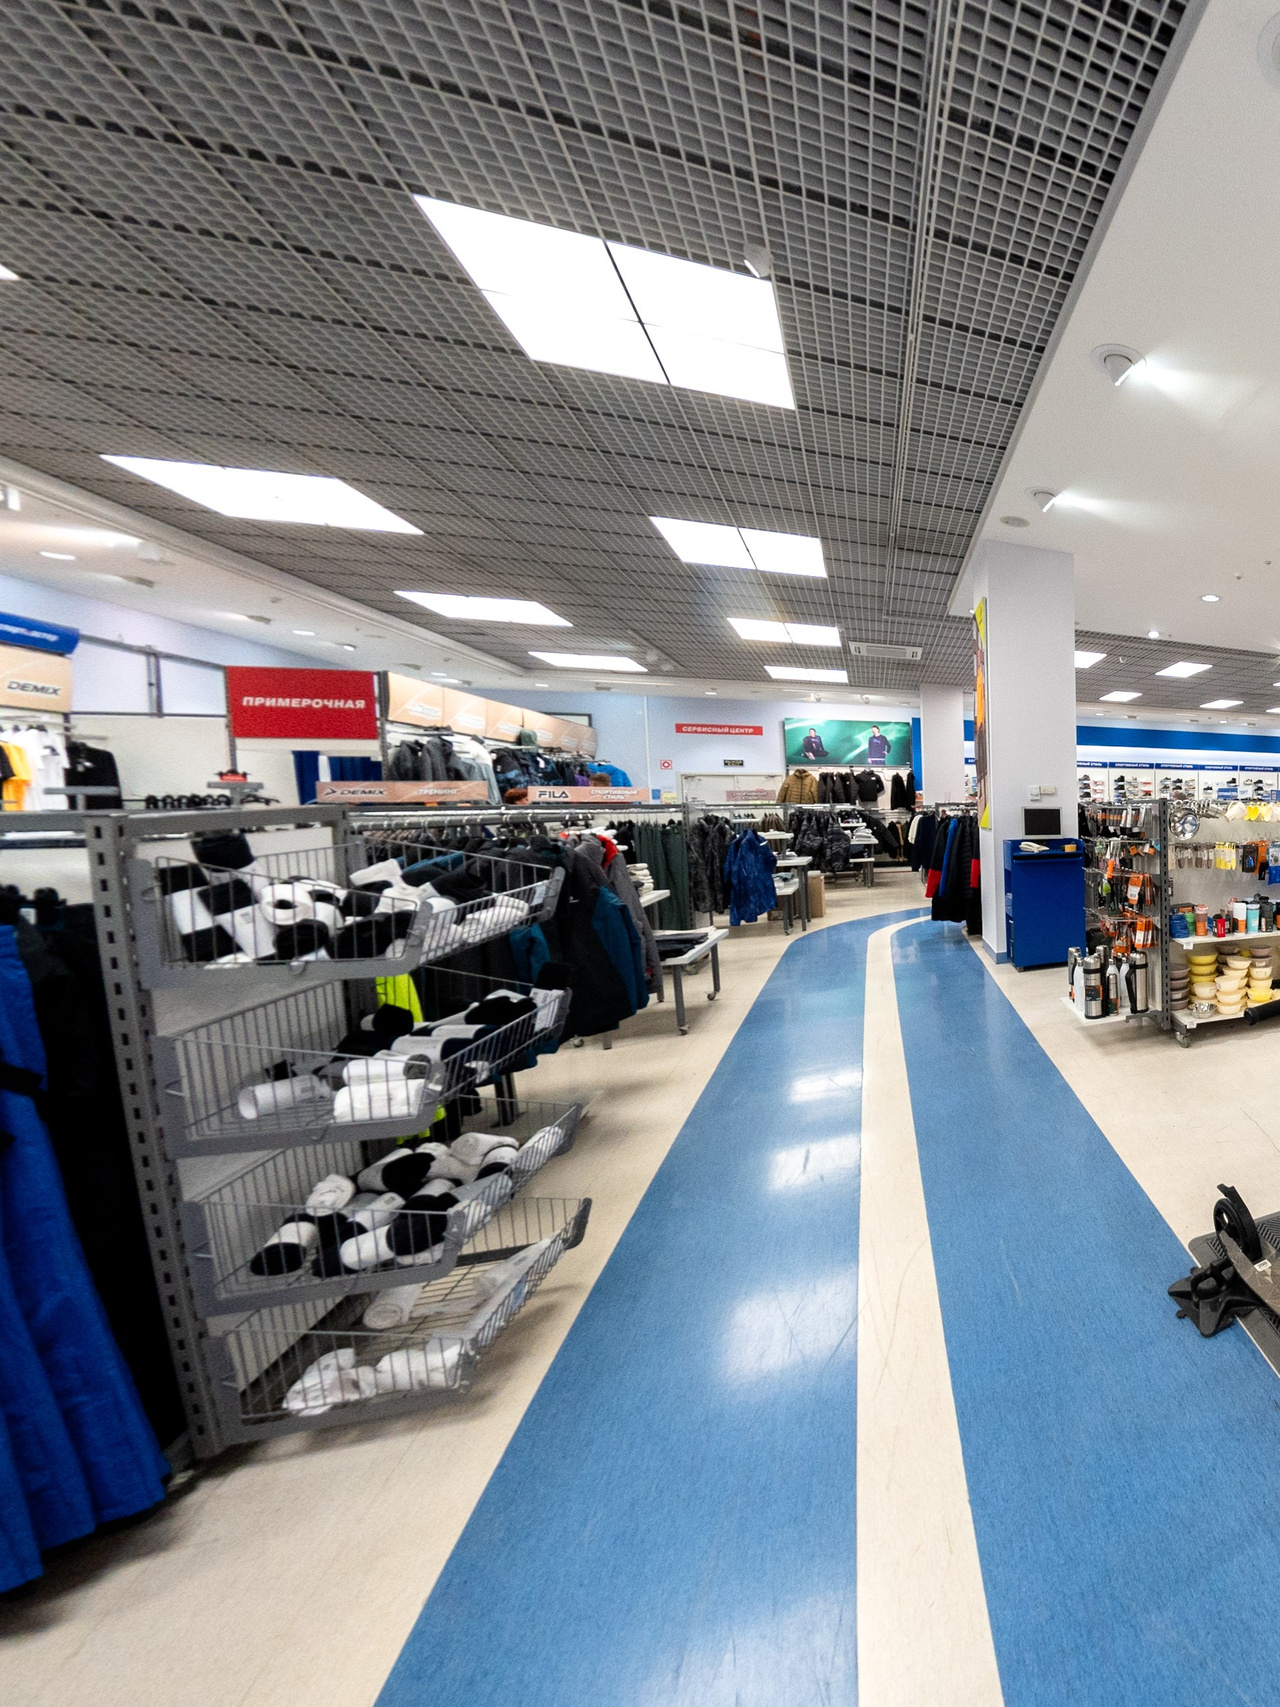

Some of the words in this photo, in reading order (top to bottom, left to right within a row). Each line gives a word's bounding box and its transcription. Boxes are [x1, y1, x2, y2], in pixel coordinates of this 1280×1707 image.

[7, 681, 61, 696] DEMIX
[242, 696, 366, 709] ПРИМЕРОЧНАЯ
[682, 725, 729, 733] СЕРВИСНЫЙ
[538, 790, 569, 799] FILA
